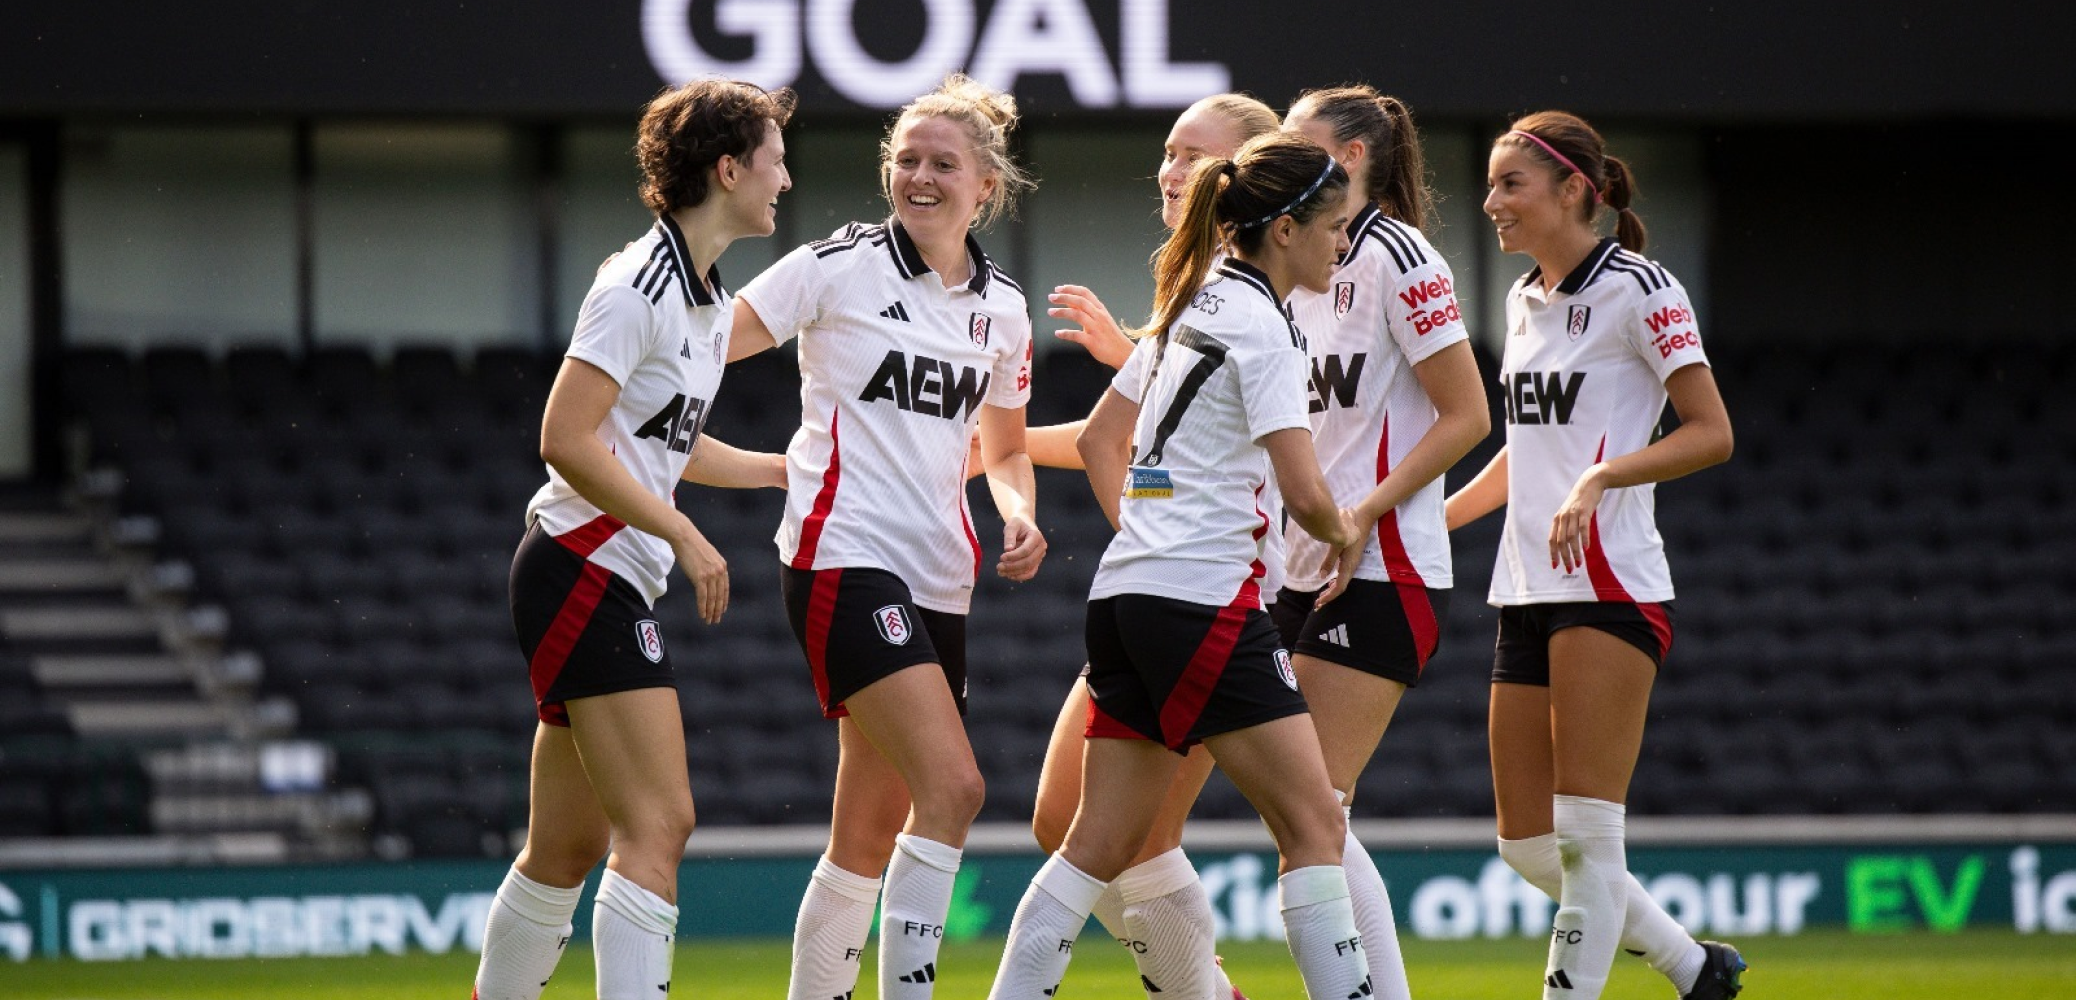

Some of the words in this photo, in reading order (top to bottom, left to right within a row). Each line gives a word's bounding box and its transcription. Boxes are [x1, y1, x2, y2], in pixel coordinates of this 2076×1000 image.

[641, 0, 1231, 108] GOAL
[1399, 274, 1452, 309] Web
[1644, 302, 1692, 334] Web
[858, 350, 991, 424] AEW
[1628, 870, 1821, 937] our
[1847, 854, 1986, 934] EV
[904, 921, 943, 939] FFC
[1059, 939, 1073, 954] FF
